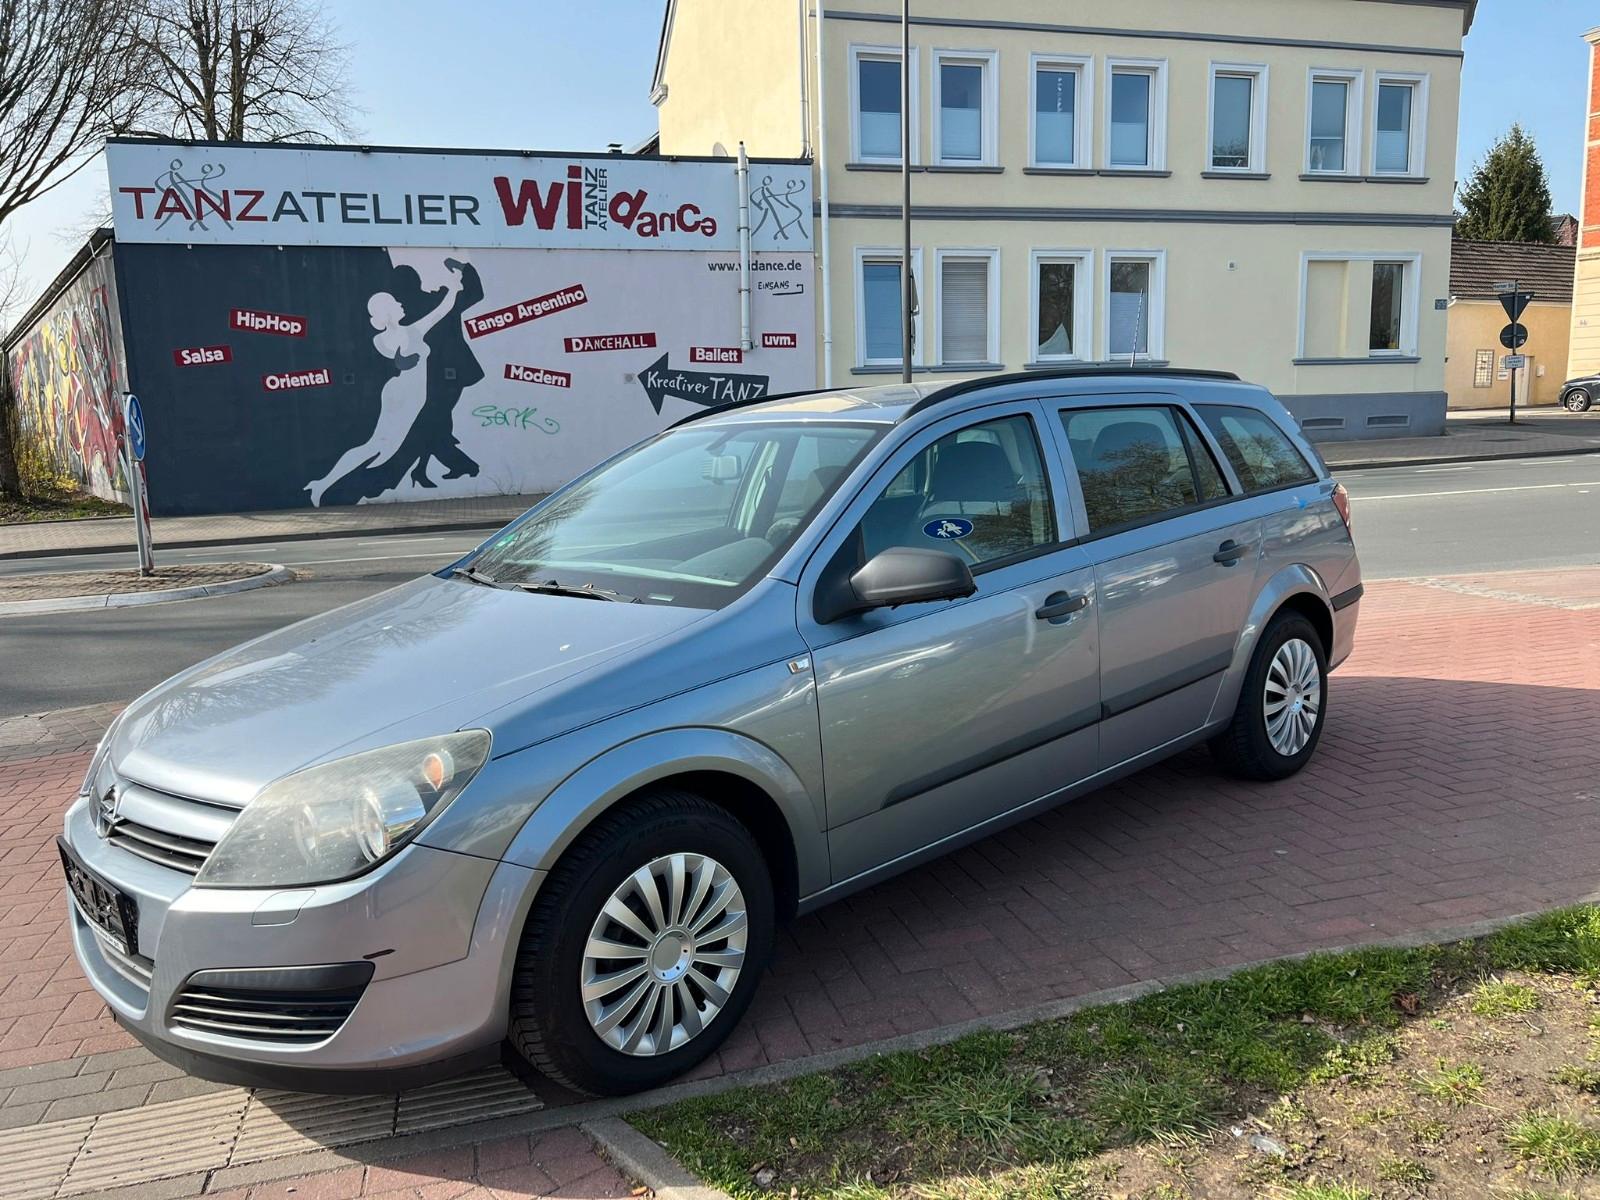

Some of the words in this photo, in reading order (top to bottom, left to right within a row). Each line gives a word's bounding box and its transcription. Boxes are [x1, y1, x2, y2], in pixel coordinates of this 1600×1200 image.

[585, 166, 598, 230] TANZ
[598, 168, 608, 231] ATELIER
[236, 311, 302, 334] HipHop
[468, 312, 514, 334] Tango
[517, 289, 585, 319] Argentino
[571, 335, 648, 352] DANCEHALL
[764, 335, 795, 346] uvm.
[181, 348, 225, 365] Salsa
[695, 348, 738, 362] Ballett
[265, 368, 330, 390] Oriental
[510, 365, 567, 387] Modern
[647, 370, 710, 394] Kreativer
[709, 377, 765, 402] TANZ
